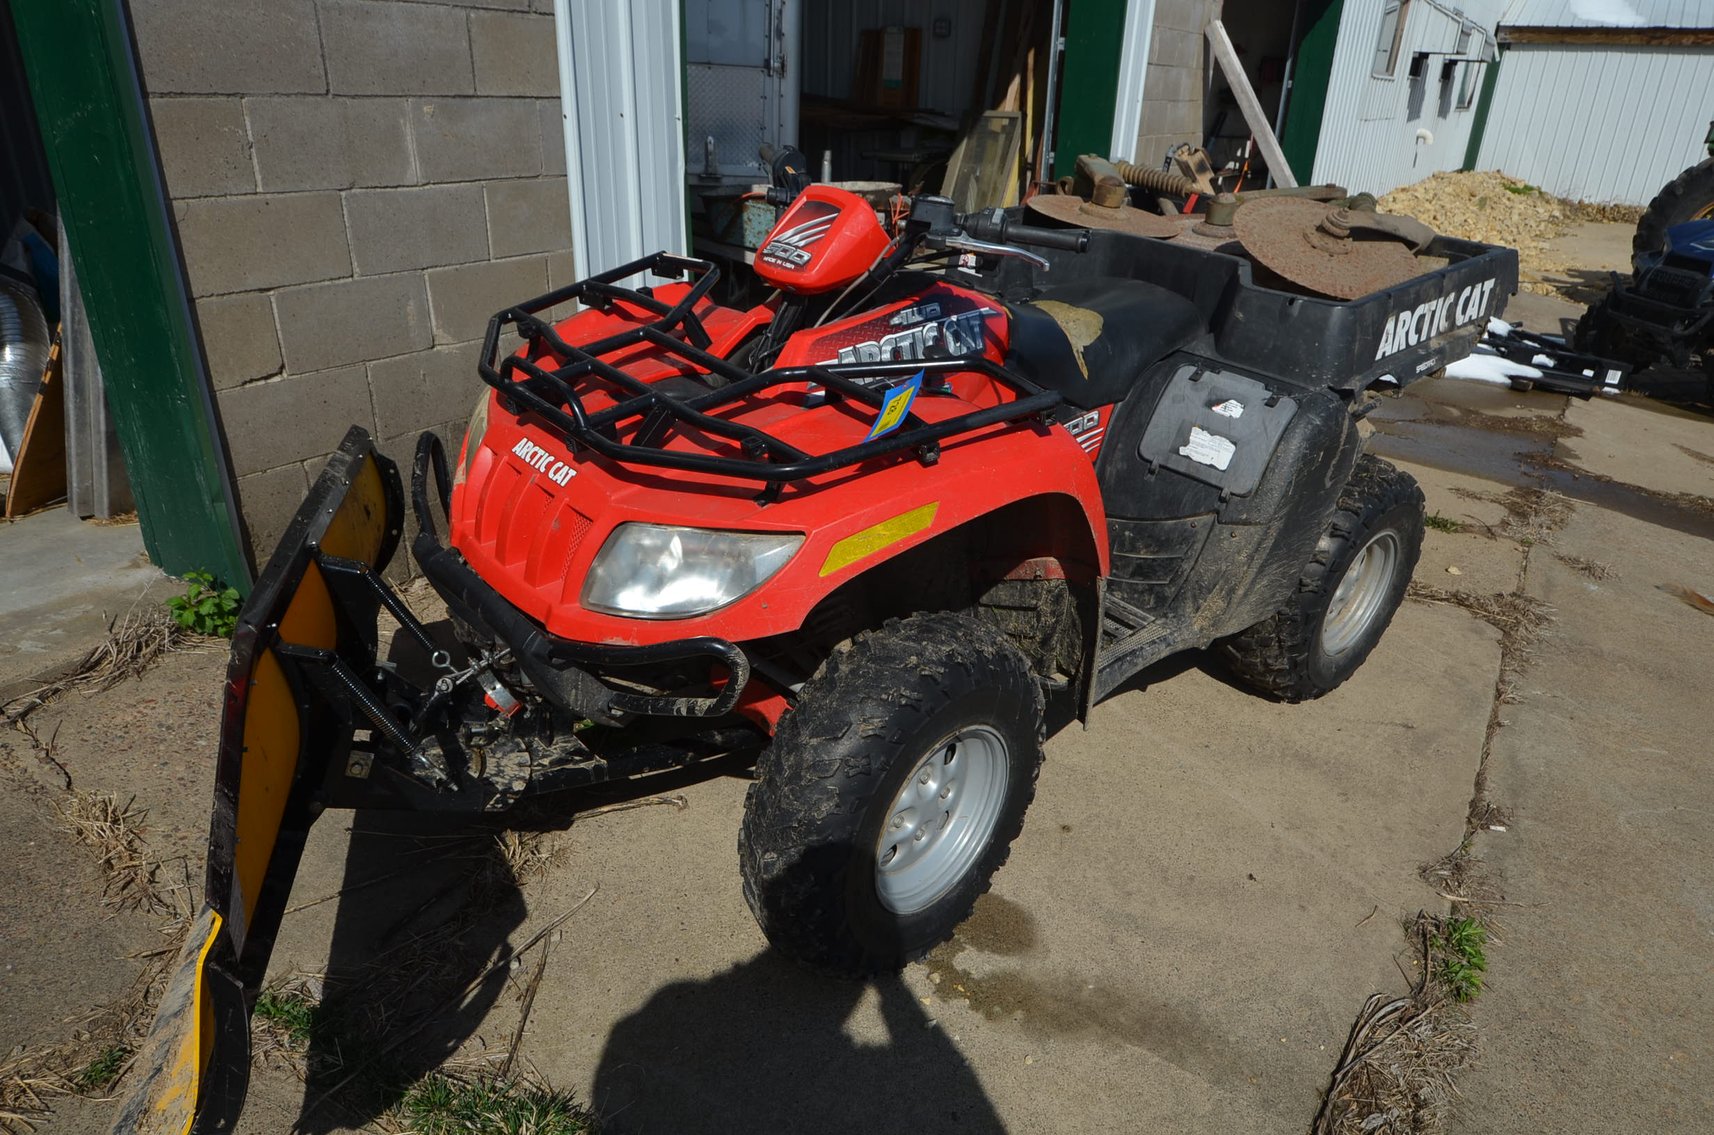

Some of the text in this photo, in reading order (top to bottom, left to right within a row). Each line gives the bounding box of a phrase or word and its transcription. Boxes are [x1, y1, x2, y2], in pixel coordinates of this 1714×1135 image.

[761, 242, 812, 266] 500
[943, 309, 987, 358] CAT
[1375, 278, 1496, 361] ARCTIC CAT
[511, 437, 577, 487] ARCTIC CAT
